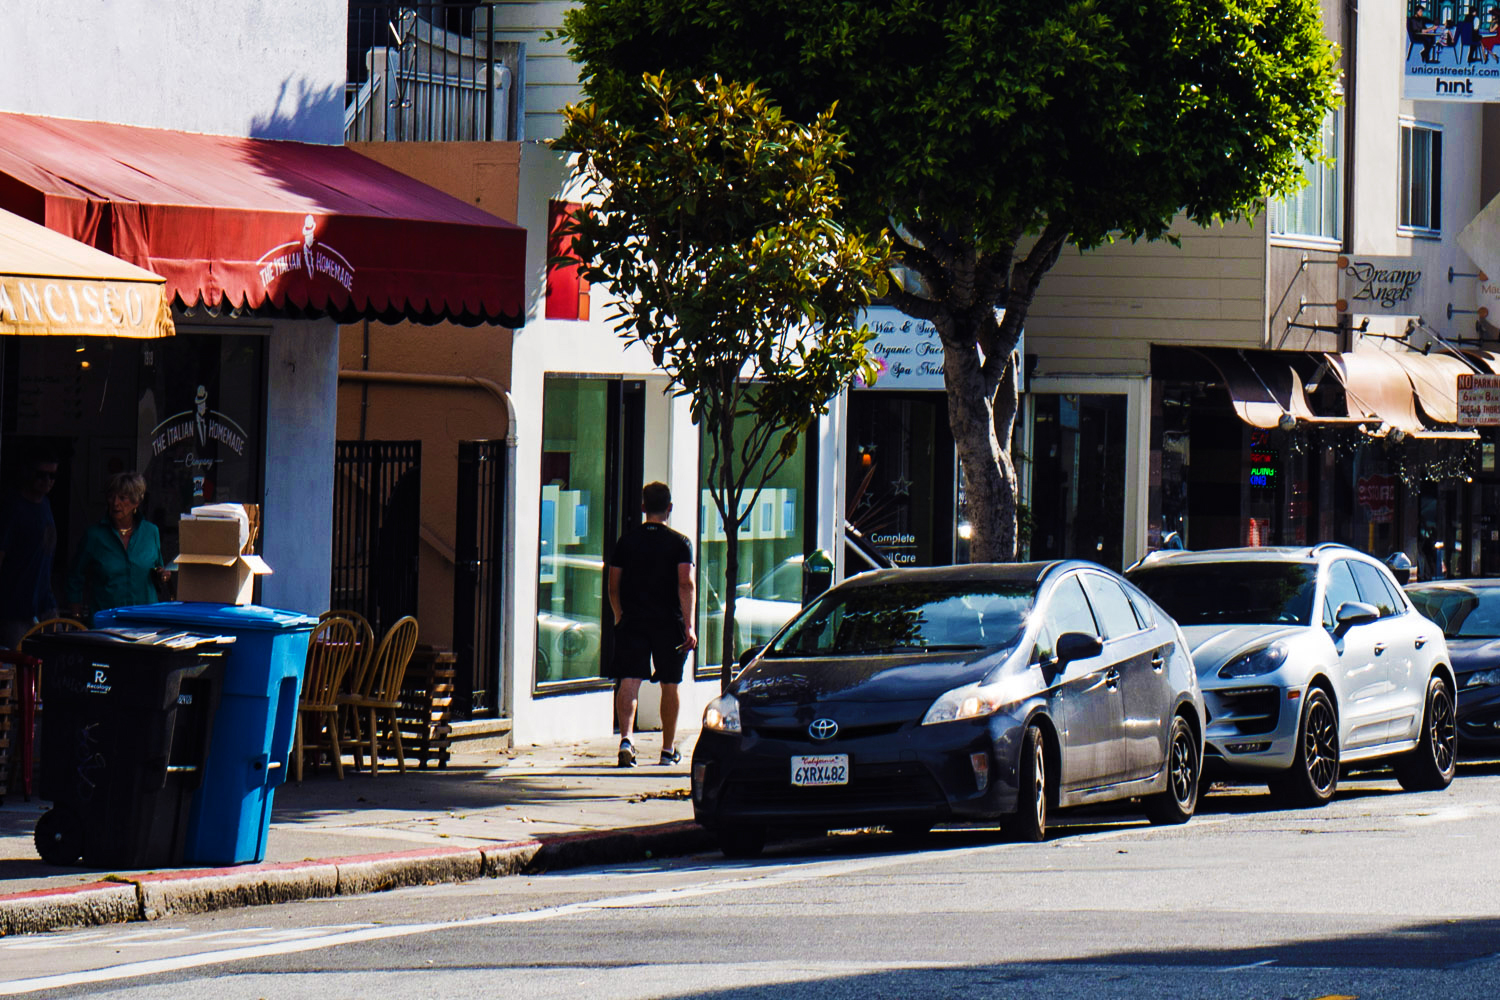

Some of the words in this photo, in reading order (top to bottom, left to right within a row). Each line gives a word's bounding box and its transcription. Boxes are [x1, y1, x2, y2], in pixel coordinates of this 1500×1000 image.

[1411, 63, 1500, 78] unionstreetsf.com
[1435, 77, 1474, 95] hint
[260, 262, 275, 288] THE
[316, 252, 354, 293] HOMEMADE
[1345, 261, 1422, 286] Dreamy
[1352, 280, 1412, 308] Angels
[873, 342, 911, 358] Organic
[890, 362, 912, 378] Spa
[1459, 375, 1472, 389] NO
[152, 433, 166, 457] THE
[167, 421, 195, 447] ITALIAN
[208, 420, 245, 456] HOMEMADE
[185, 452, 214, 470] Company
[871, 533, 915, 545] Complete
[894, 553, 916, 563] Care
[86, 682, 111, 692] Recology
[802, 757, 836, 766] California
[795, 766, 845, 784] 6XRX482
